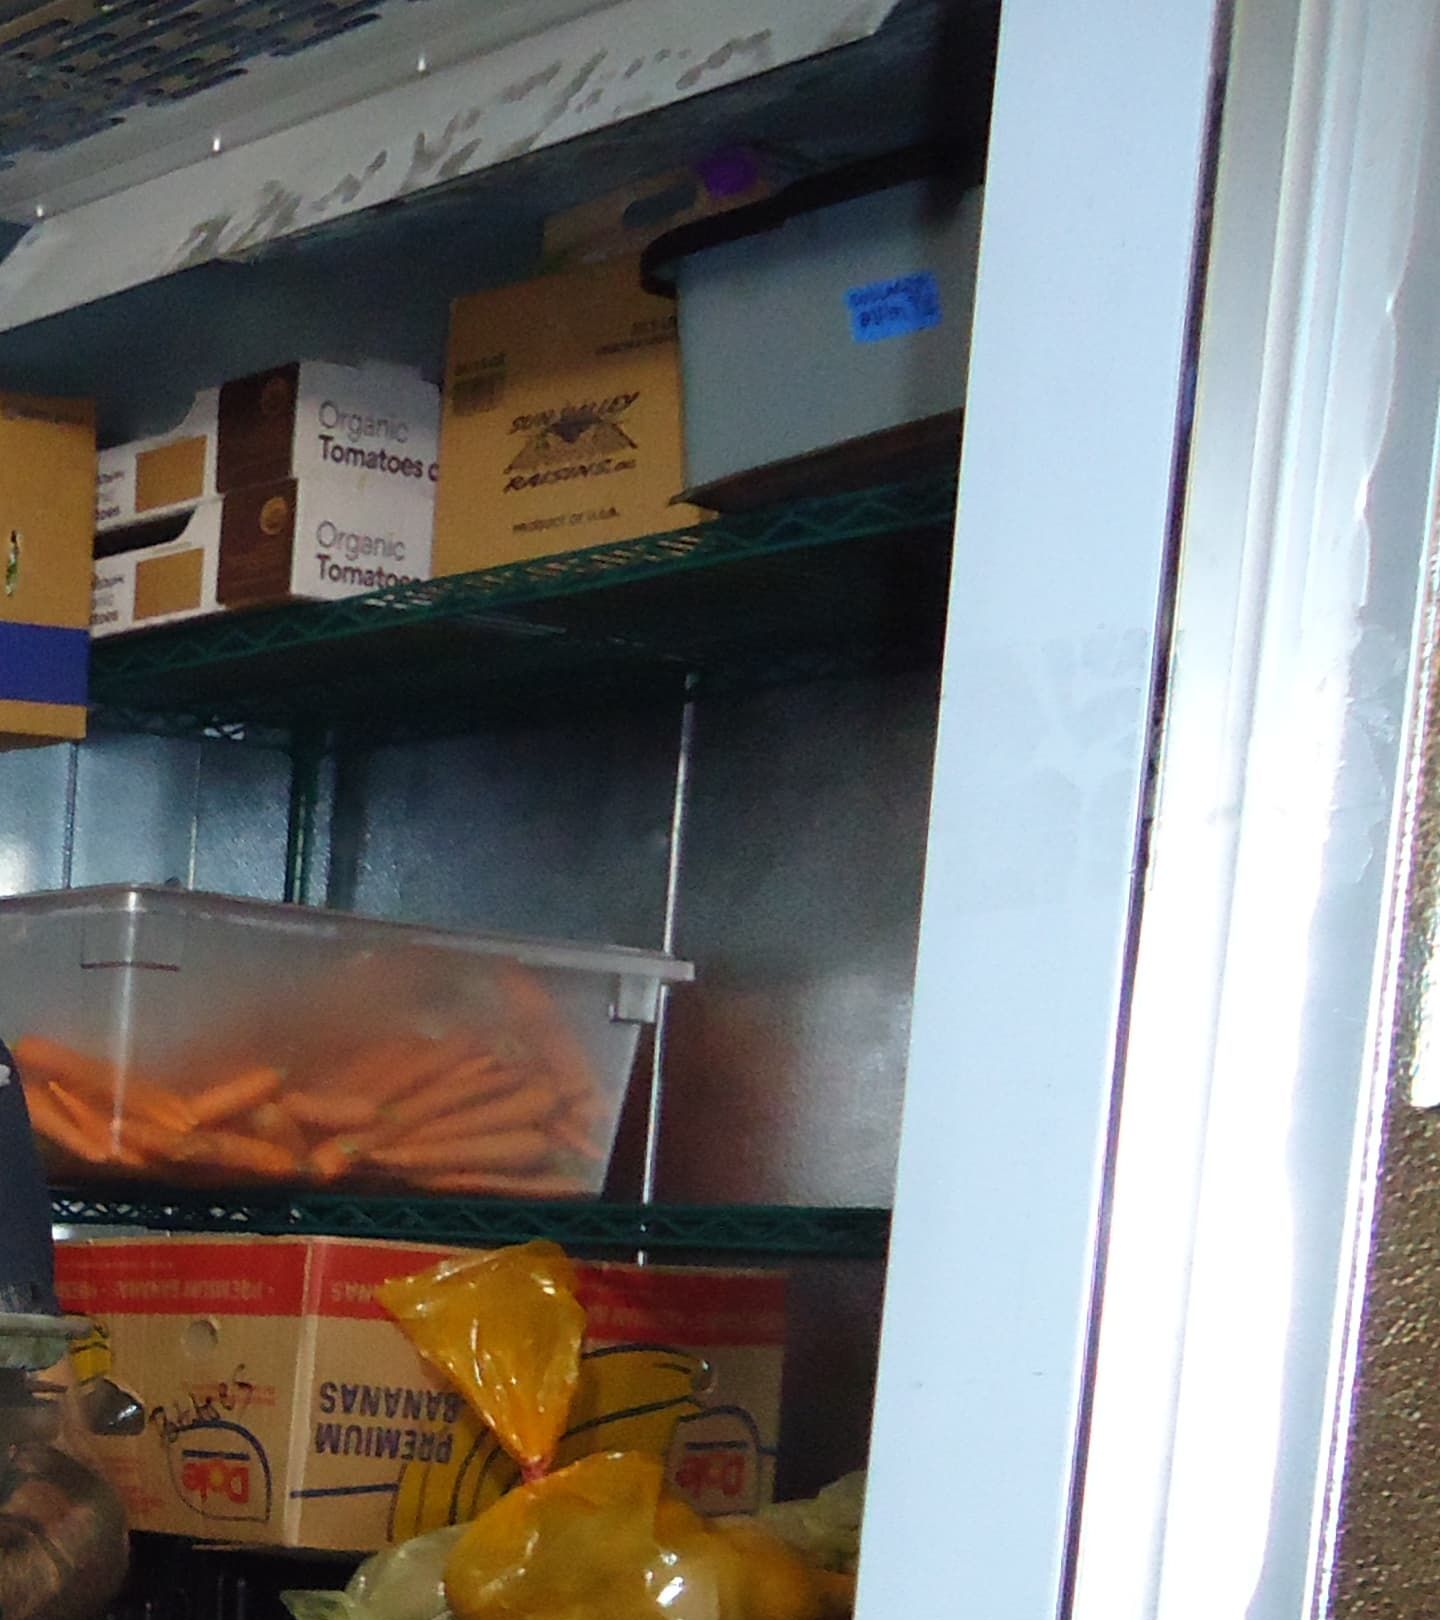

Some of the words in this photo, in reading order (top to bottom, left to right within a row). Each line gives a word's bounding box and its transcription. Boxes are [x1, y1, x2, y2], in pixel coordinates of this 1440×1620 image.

[318, 400, 410, 444] Organic
[317, 434, 424, 479] Tomatoes
[316, 519, 407, 561] Organic
[320, 1382, 464, 1425] BANANAS
[315, 1423, 453, 1465] PREMIUM
[182, 1459, 250, 1504] Dole
